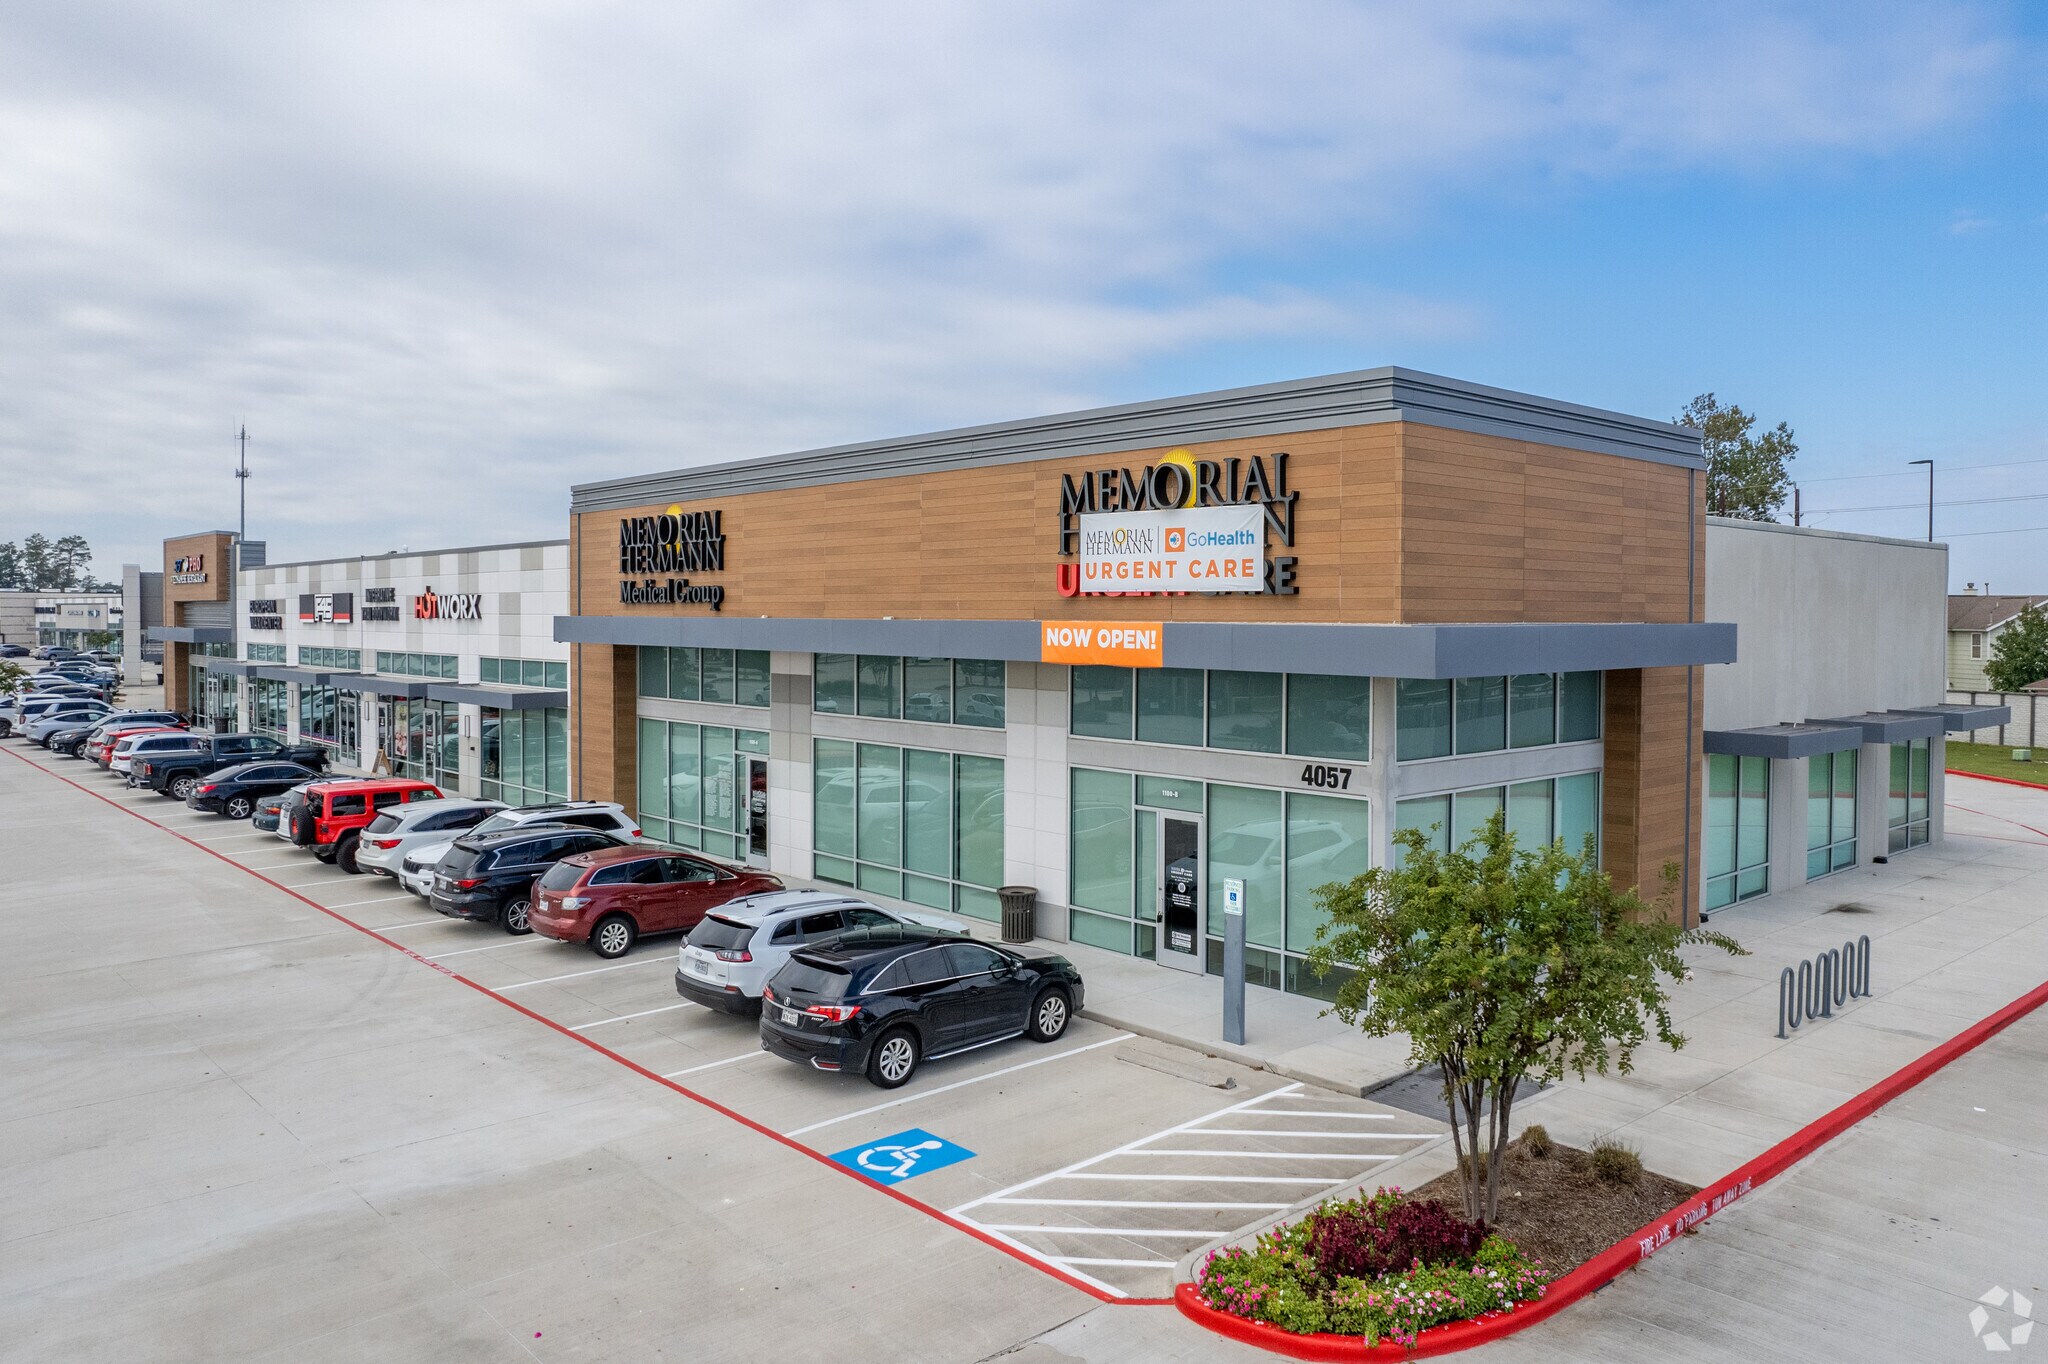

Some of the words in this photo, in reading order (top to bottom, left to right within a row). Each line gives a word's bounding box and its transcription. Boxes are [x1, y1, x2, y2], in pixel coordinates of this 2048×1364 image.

[1058, 453, 1300, 515] MEMORIAL
[619, 510, 726, 546] MEMORIAL
[1086, 527, 1154, 544] MEMORIAL
[1187, 530, 1255, 546] GoHealth
[619, 541, 725, 573] HERMANN
[1086, 541, 1153, 556] HERMANN
[1085, 560, 1177, 579] URGENT
[1188, 558, 1254, 578] CARE
[619, 579, 675, 604] Medical
[674, 579, 725, 611] Group
[1046, 628, 1092, 647] NOW
[1097, 629, 1157, 650] OPEN!
[1301, 764, 1353, 790] 4057
[1638, 1236, 1655, 1257] FIRE
[1654, 1225, 1671, 1248] LANE
[1675, 1218, 1684, 1234] NO
[1683, 1202, 1708, 1228] PARKING
[1712, 1195, 1723, 1213] TOW
[1723, 1185, 1738, 1205] AWAY
